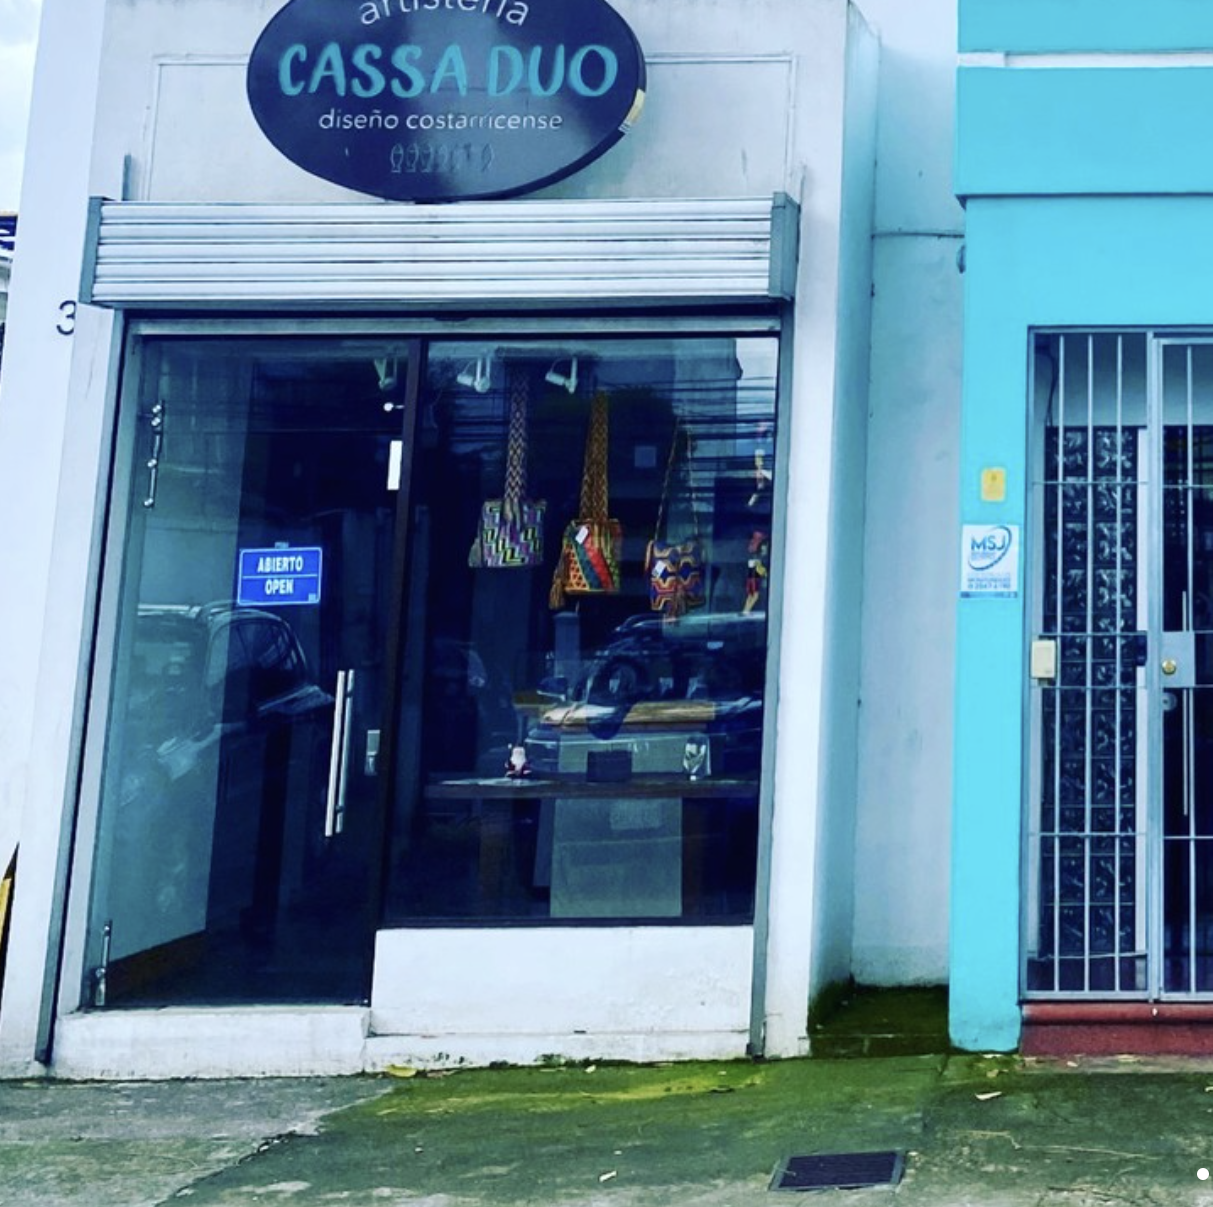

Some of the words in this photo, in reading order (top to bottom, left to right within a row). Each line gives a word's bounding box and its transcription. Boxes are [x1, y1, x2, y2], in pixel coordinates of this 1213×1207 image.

[278, 41, 468, 97] CASSA
[487, 43, 619, 97] DUO
[318, 108, 399, 131] diseño
[406, 111, 563, 131] costarricense
[970, 535, 1006, 551] MSJ
[257, 556, 303, 572] ABIERTO
[265, 578, 294, 595] OPEN
